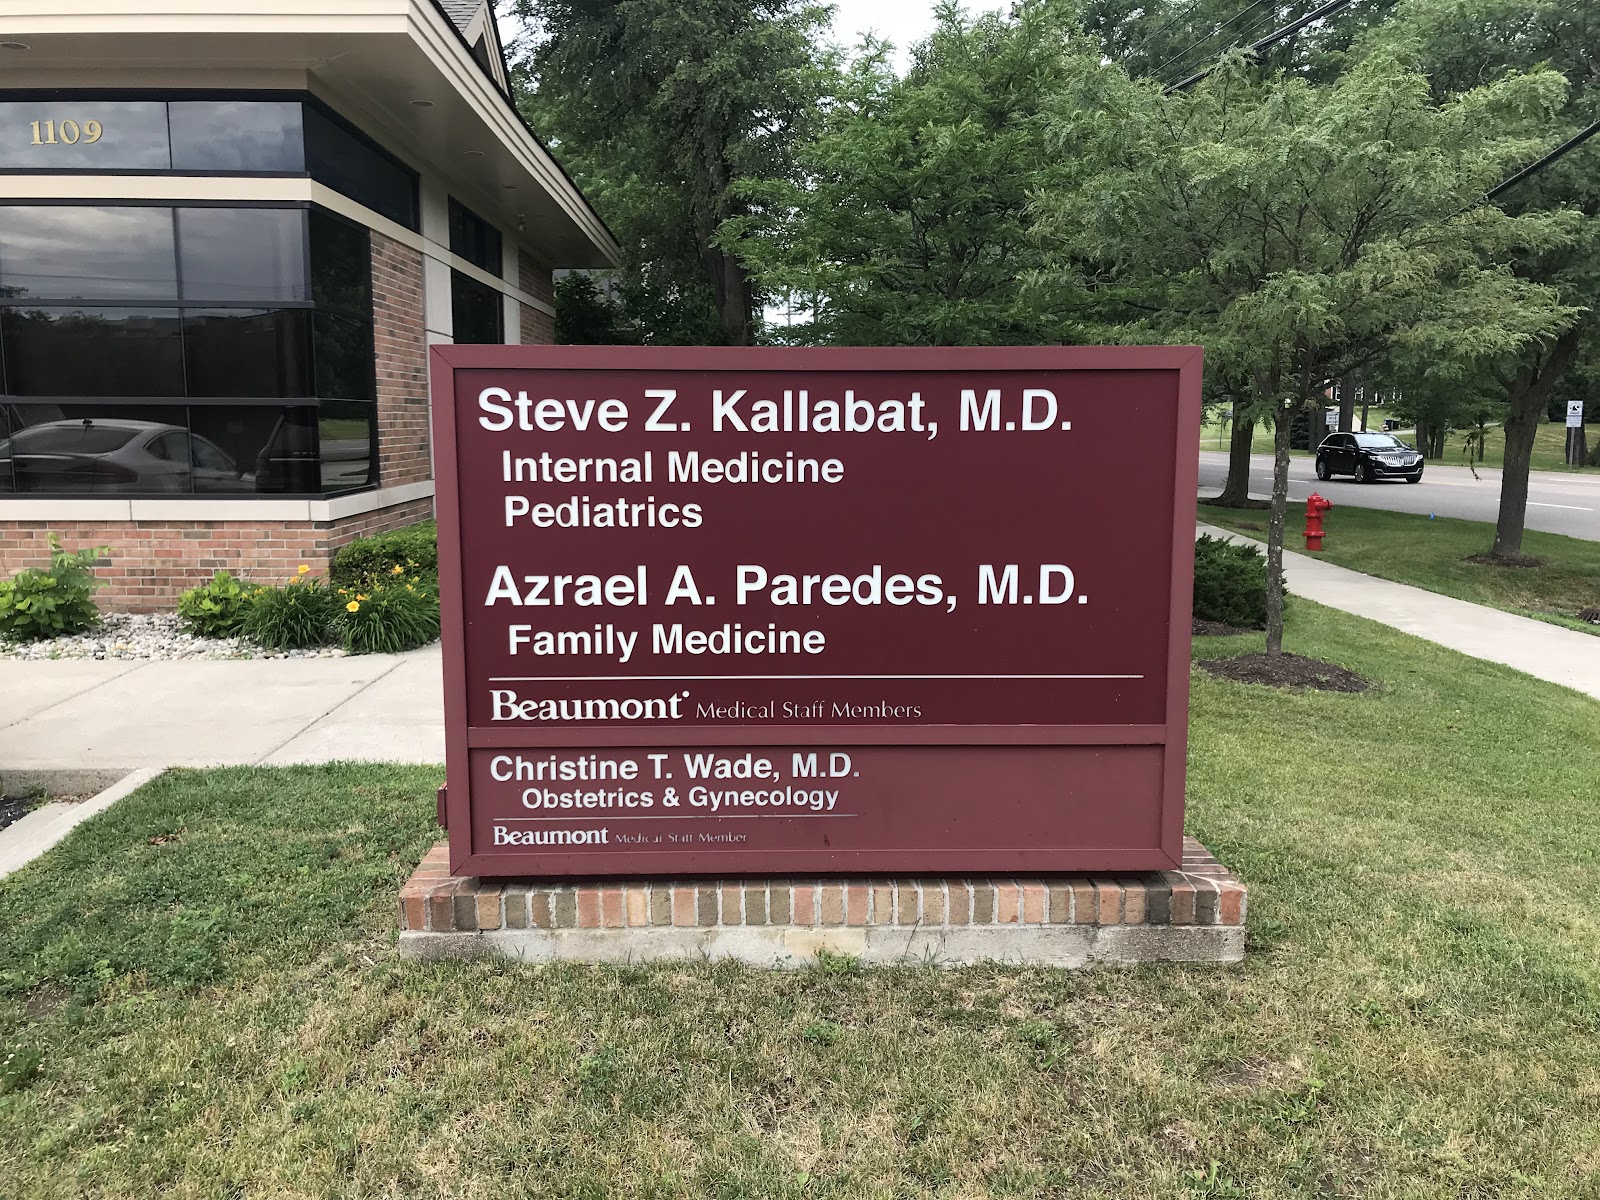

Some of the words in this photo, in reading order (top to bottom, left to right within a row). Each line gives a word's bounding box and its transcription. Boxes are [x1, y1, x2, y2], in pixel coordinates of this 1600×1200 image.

[30, 119, 103, 145] 1109
[478, 386, 629, 433] Steve
[644, 389, 691, 432] Z.
[712, 389, 938, 441] Kallabat,
[959, 388, 1072, 432] M.D.
[502, 449, 653, 483] Internal
[667, 450, 845, 484] Medicine
[504, 495, 703, 528] Pediatrics
[484, 564, 648, 607] Azrael
[664, 564, 716, 606] A.
[736, 564, 957, 614] Paredes,
[978, 563, 1088, 605] M.D.
[508, 623, 639, 663] Family
[652, 622, 826, 655] Medicine
[489, 689, 686, 721] Beaumont
[695, 700, 775, 720] Medical
[782, 700, 825, 719] Staff
[831, 700, 923, 719] Members
[489, 754, 639, 782] Christine
[646, 753, 673, 780] T.
[683, 752, 780, 783] Wade,
[792, 752, 861, 778] M.D.
[521, 786, 654, 809] Obstetrics
[662, 786, 681, 808] &
[688, 785, 840, 812] Gynecology
[492, 825, 610, 846] Beaumont
[614, 833, 663, 844] Medical
[668, 832, 694, 843] Staff
[698, 831, 748, 843] Member
